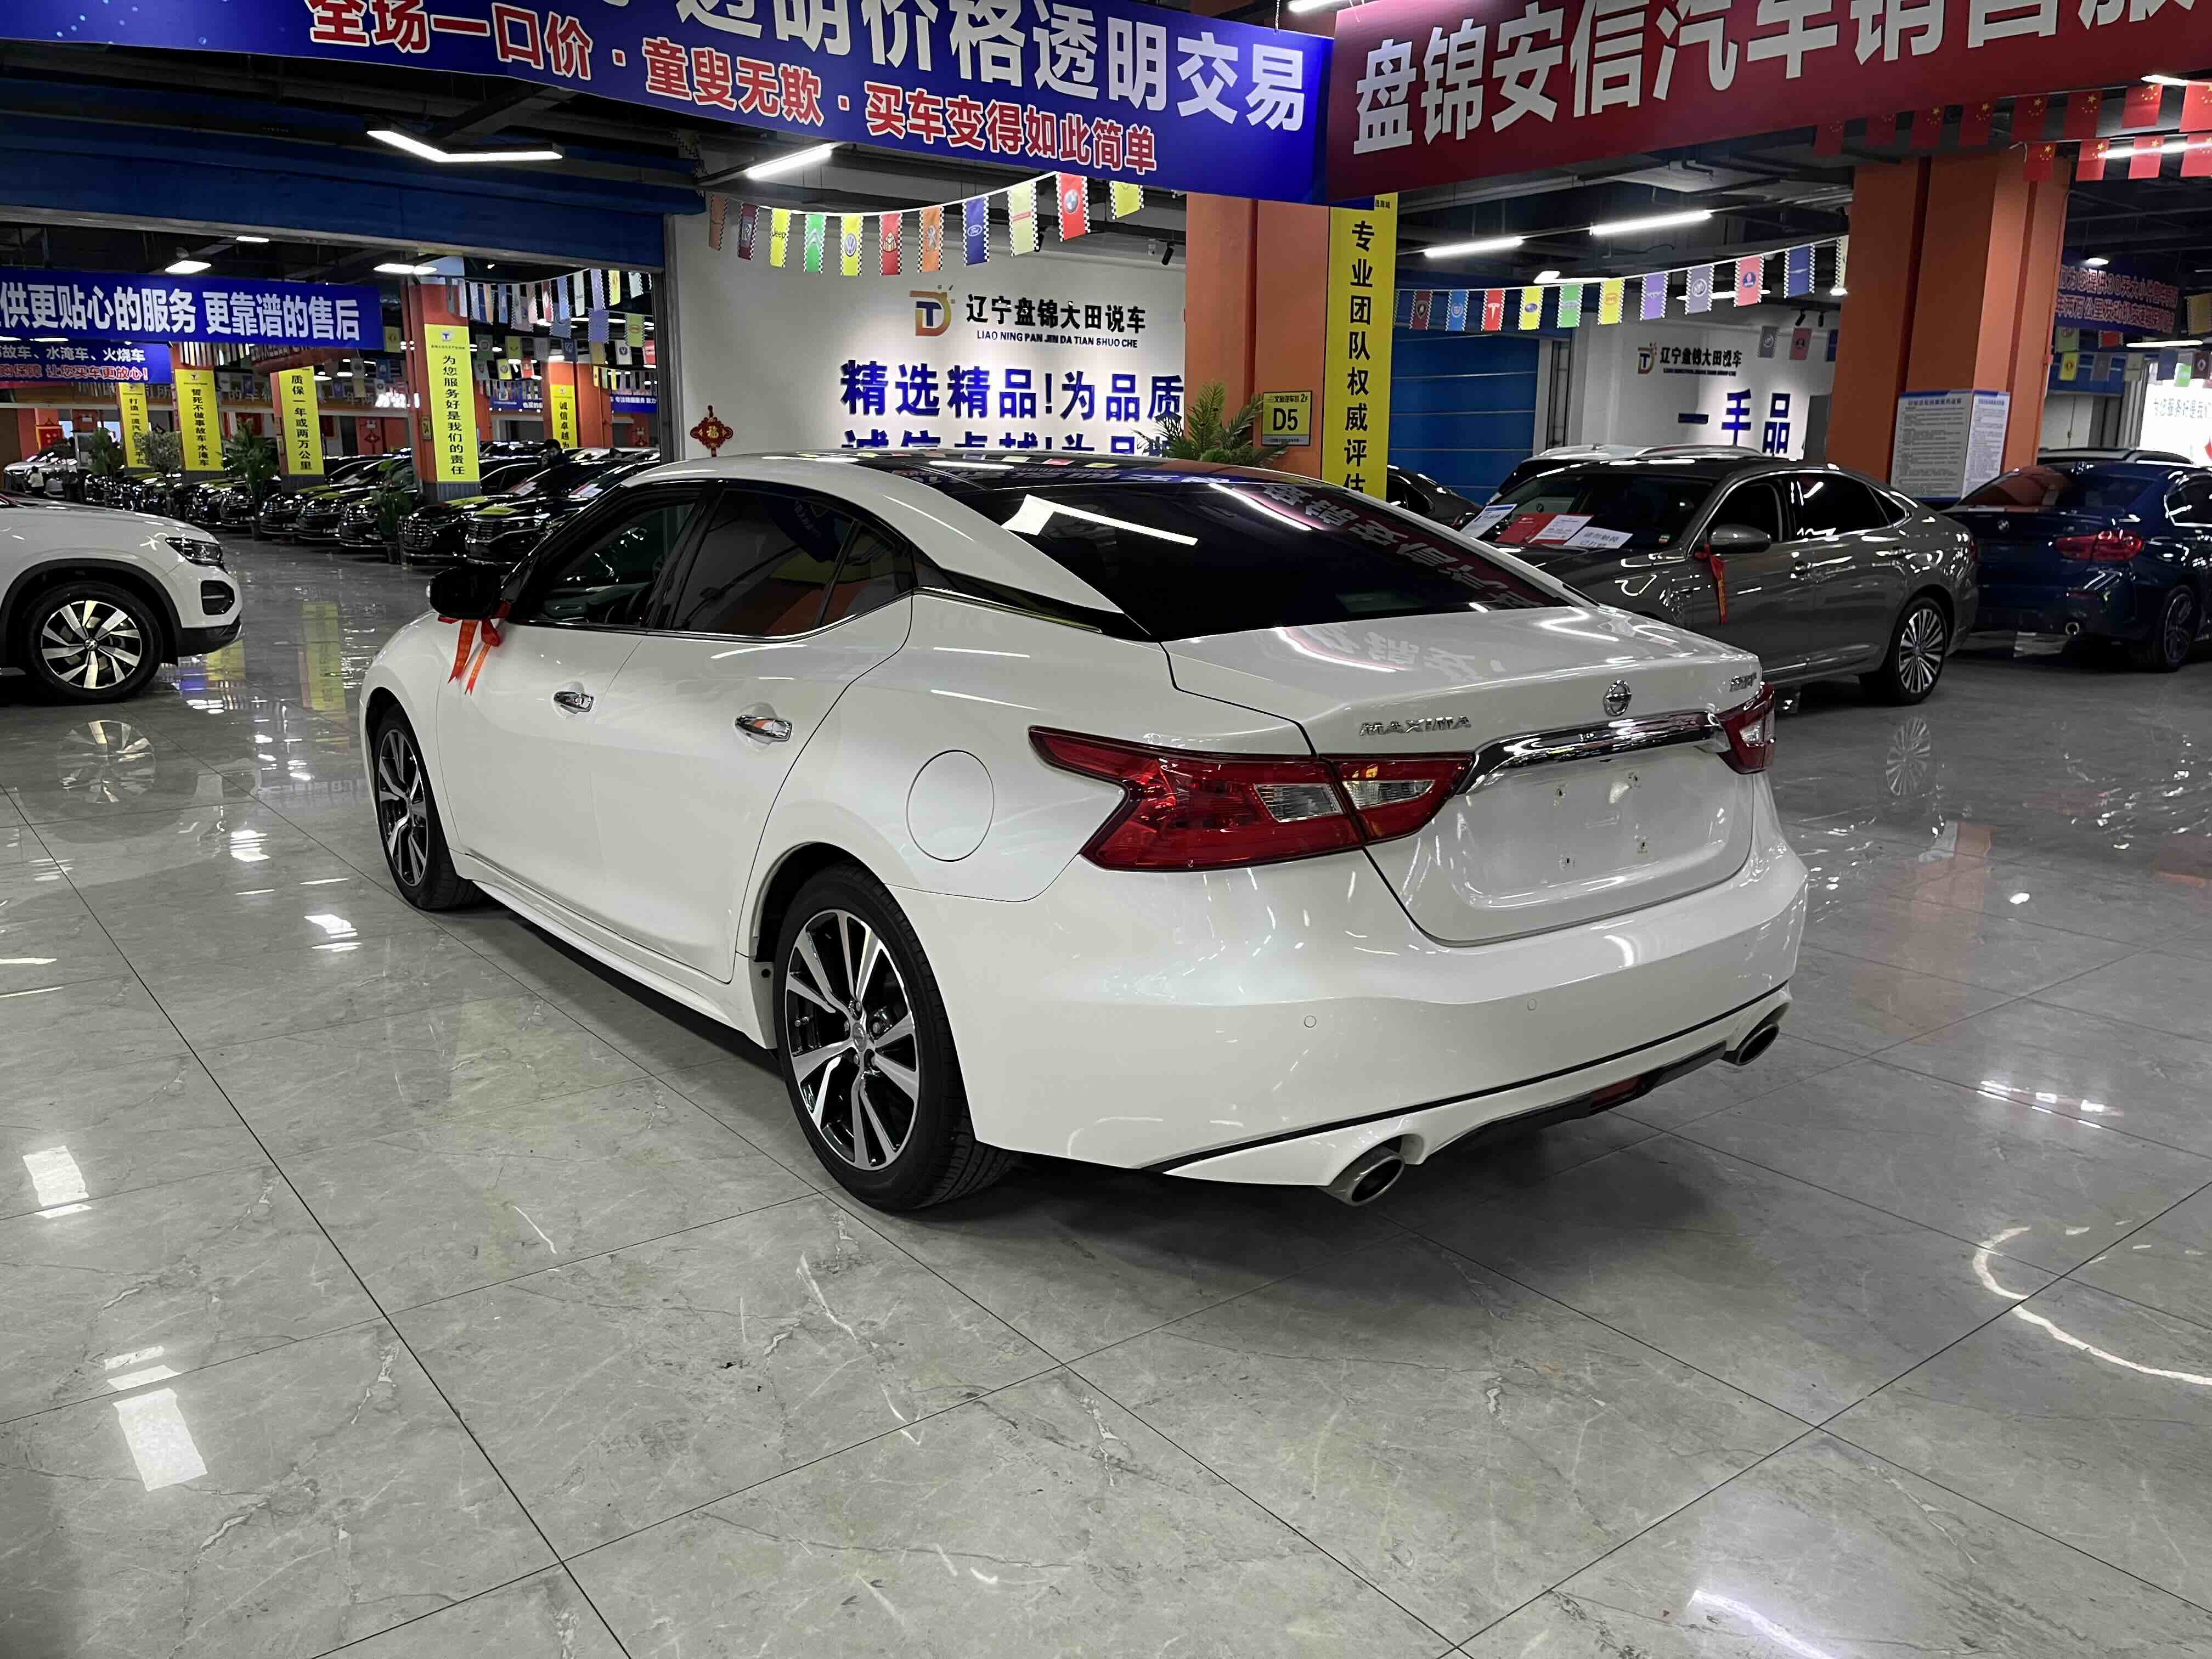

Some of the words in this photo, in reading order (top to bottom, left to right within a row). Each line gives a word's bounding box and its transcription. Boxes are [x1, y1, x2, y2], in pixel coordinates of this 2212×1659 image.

[0, 281, 197, 334] 供更贴心的服务
[202, 291, 360, 341] 更靠谱的售后
[966, 294, 1146, 334] 辽宁盘锦大田说车
[0, 345, 145, 363] 故车、水淹车、火烧车
[977, 330, 997, 340] LIAO
[1001, 332, 1023, 341] NING
[1025, 332, 1043, 342] PAN
[1060, 335, 1073, 344] DA
[1074, 336, 1094, 345] TIAN
[1096, 337, 1120, 347] SHUO
[1122, 339, 1138, 348] CHE
[1344, 220, 1375, 493] 专业团队权威评估
[291, 375, 322, 470] 质保一年或两万公里
[443, 355, 465, 475] 为您服务好是我们的责任
[1273, 408, 1299, 431] D5
[1360, 715, 1472, 736] MAXIMA
